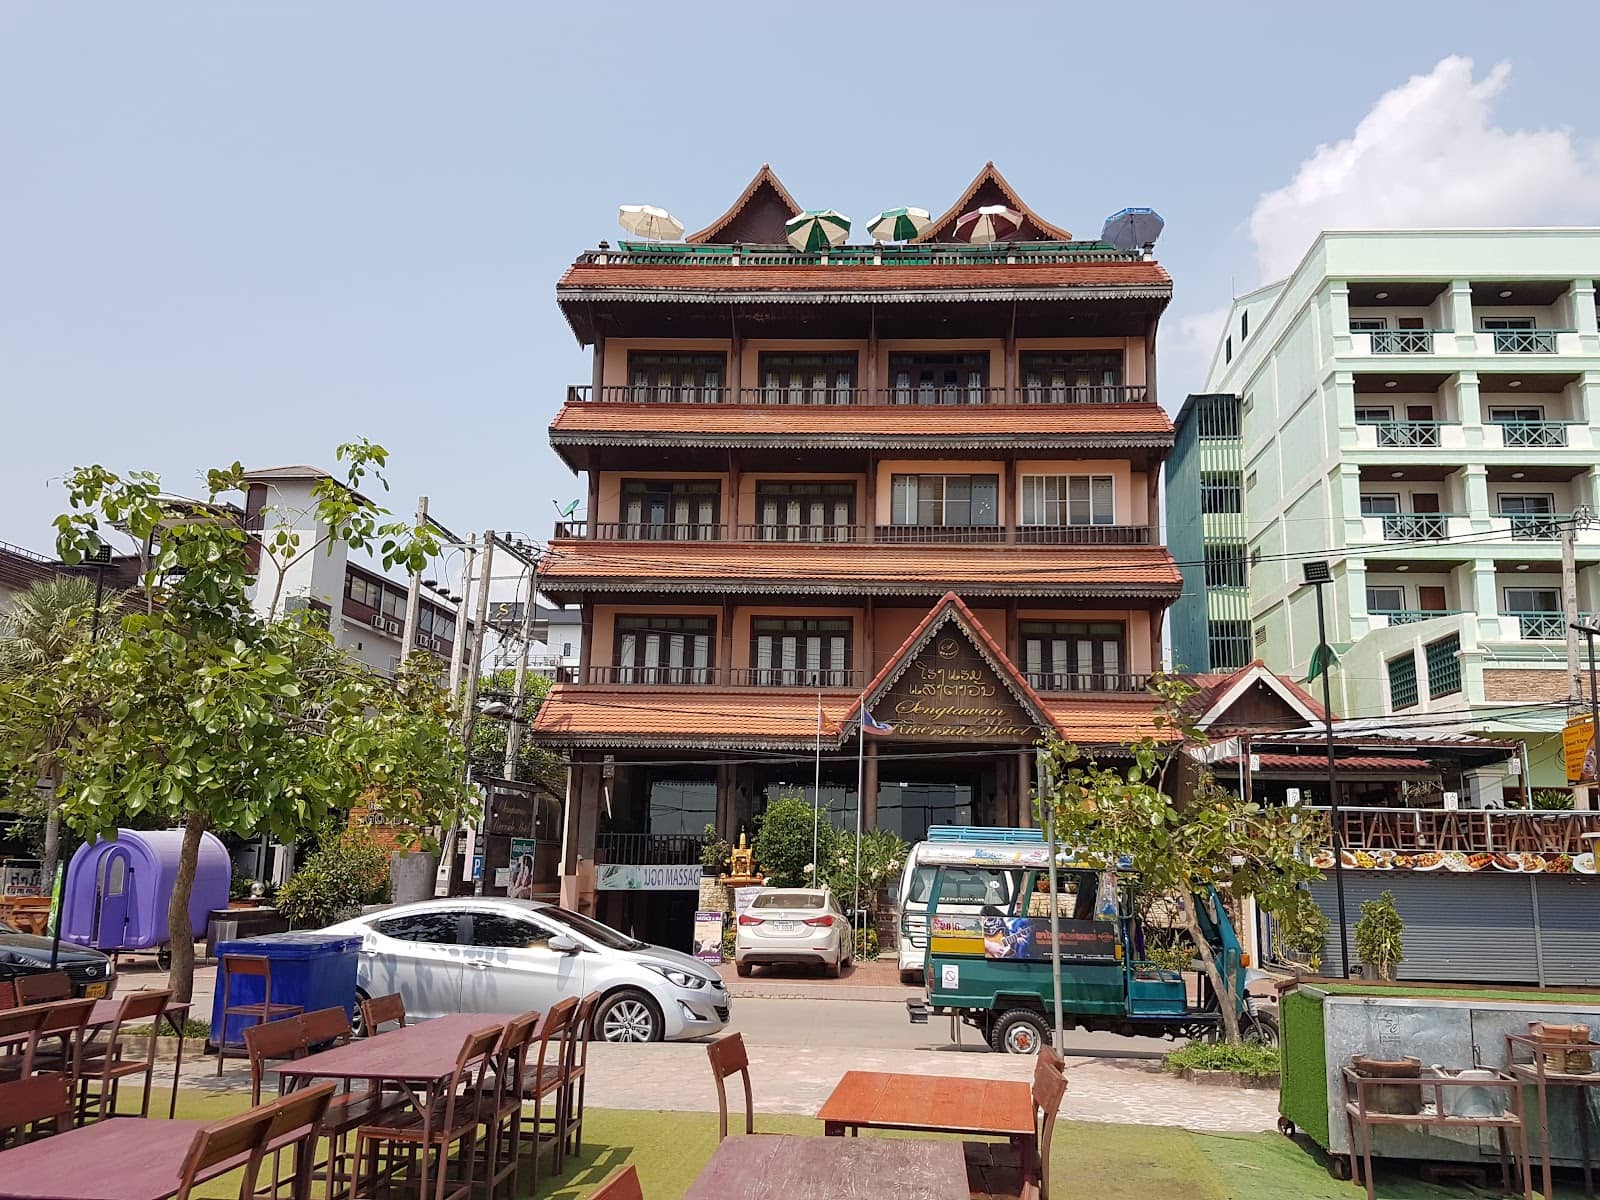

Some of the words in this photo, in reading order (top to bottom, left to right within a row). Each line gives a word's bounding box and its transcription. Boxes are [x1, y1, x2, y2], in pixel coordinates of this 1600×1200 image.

[896, 700, 1005, 720] Sengtawan
[890, 720, 973, 736] Riverside
[973, 717, 1032, 736] Hotel
[474, 858, 481, 874] P
